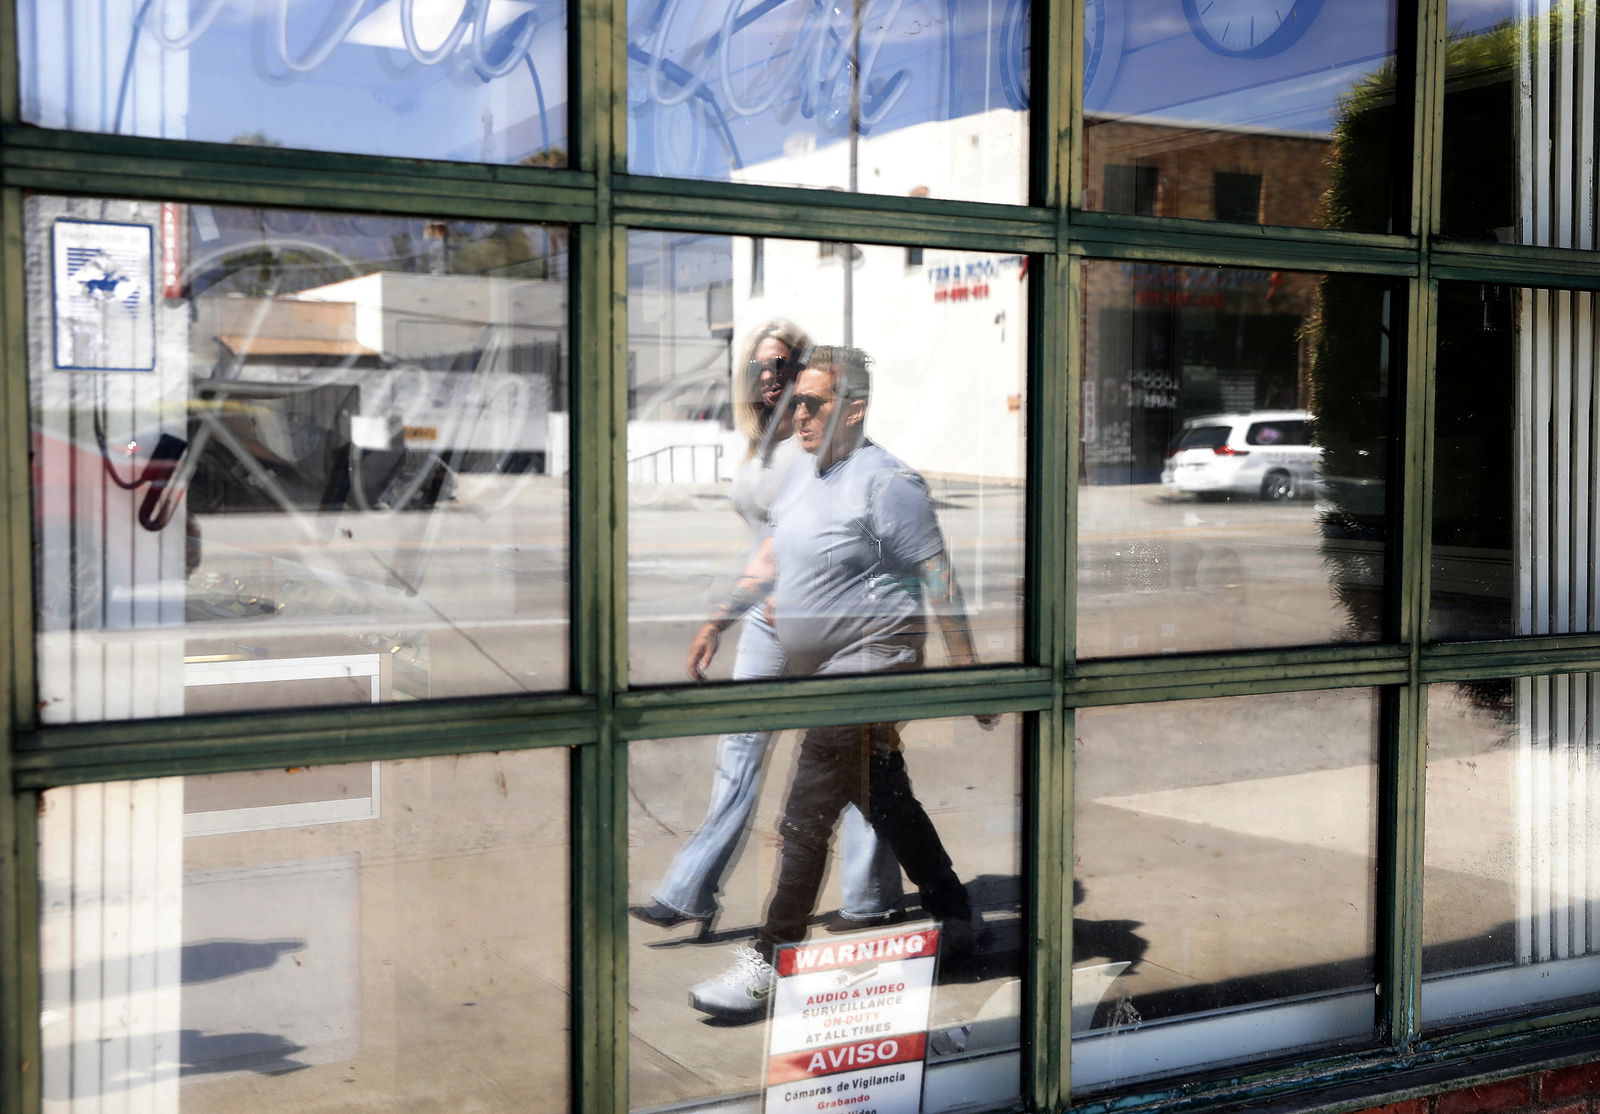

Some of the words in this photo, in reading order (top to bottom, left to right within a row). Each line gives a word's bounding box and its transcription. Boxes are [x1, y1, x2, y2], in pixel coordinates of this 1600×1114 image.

[796, 935, 925, 969] WARNING
[806, 991, 848, 1006] AUDIO
[852, 989, 860, 998] &
[866, 983, 905, 996] VIDEO
[802, 995, 903, 1019] SURVEILLANCE
[805, 1033, 821, 1044] AT
[824, 1029, 848, 1041] ALL
[852, 1022, 892, 1036] TIMES
[806, 1040, 898, 1073] AVISO
[836, 1081, 850, 1092] de
[852, 1073, 906, 1090] Vigilancia
[817, 1094, 870, 1110] Grabando
